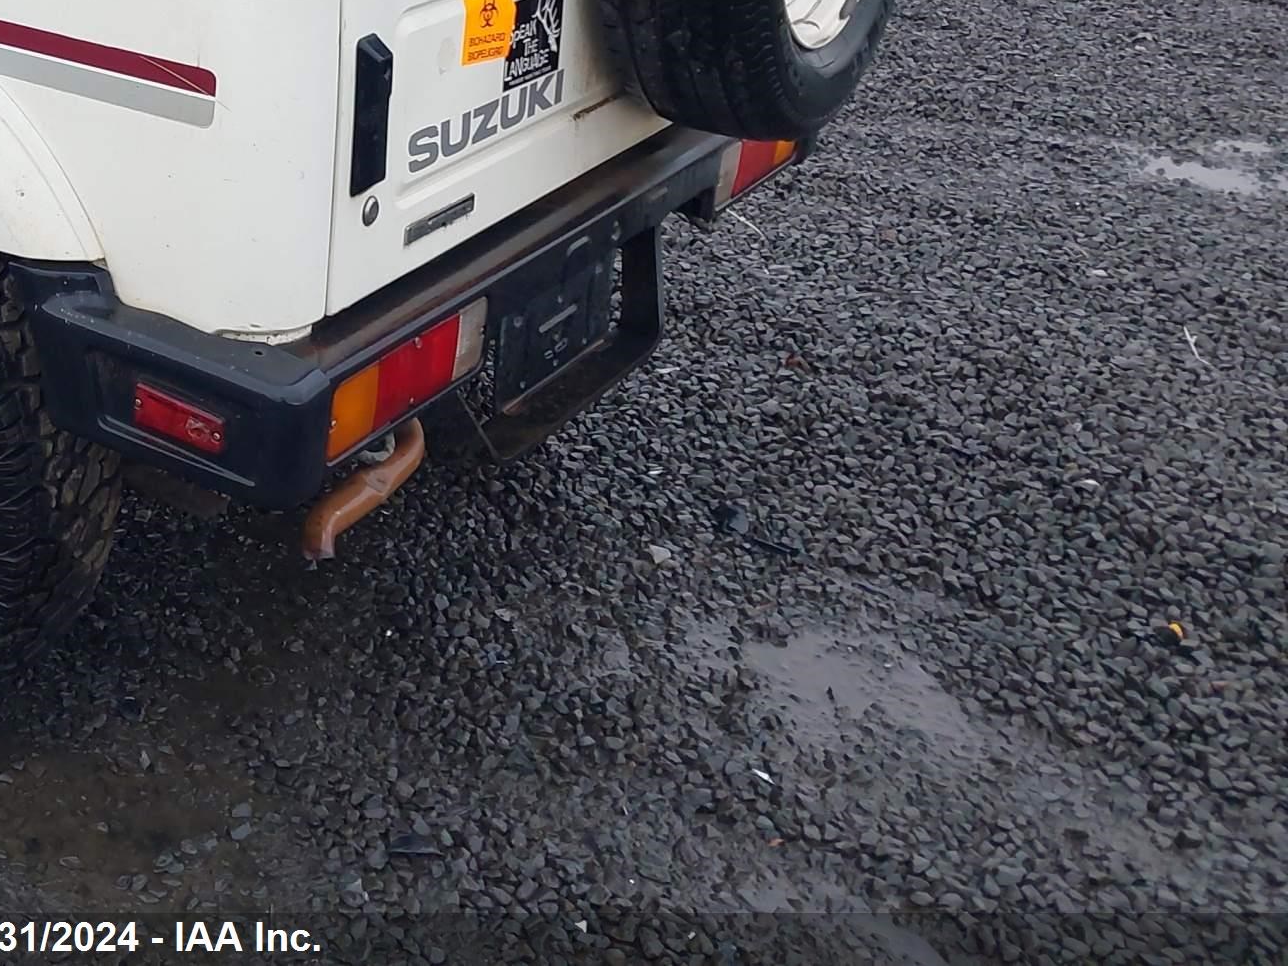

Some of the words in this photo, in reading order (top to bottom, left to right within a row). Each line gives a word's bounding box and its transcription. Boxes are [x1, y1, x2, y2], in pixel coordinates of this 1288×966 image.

[522, 38, 540, 56] THE
[504, 48, 550, 82] LANGUAGE
[407, 68, 565, 174] SUZUKI
